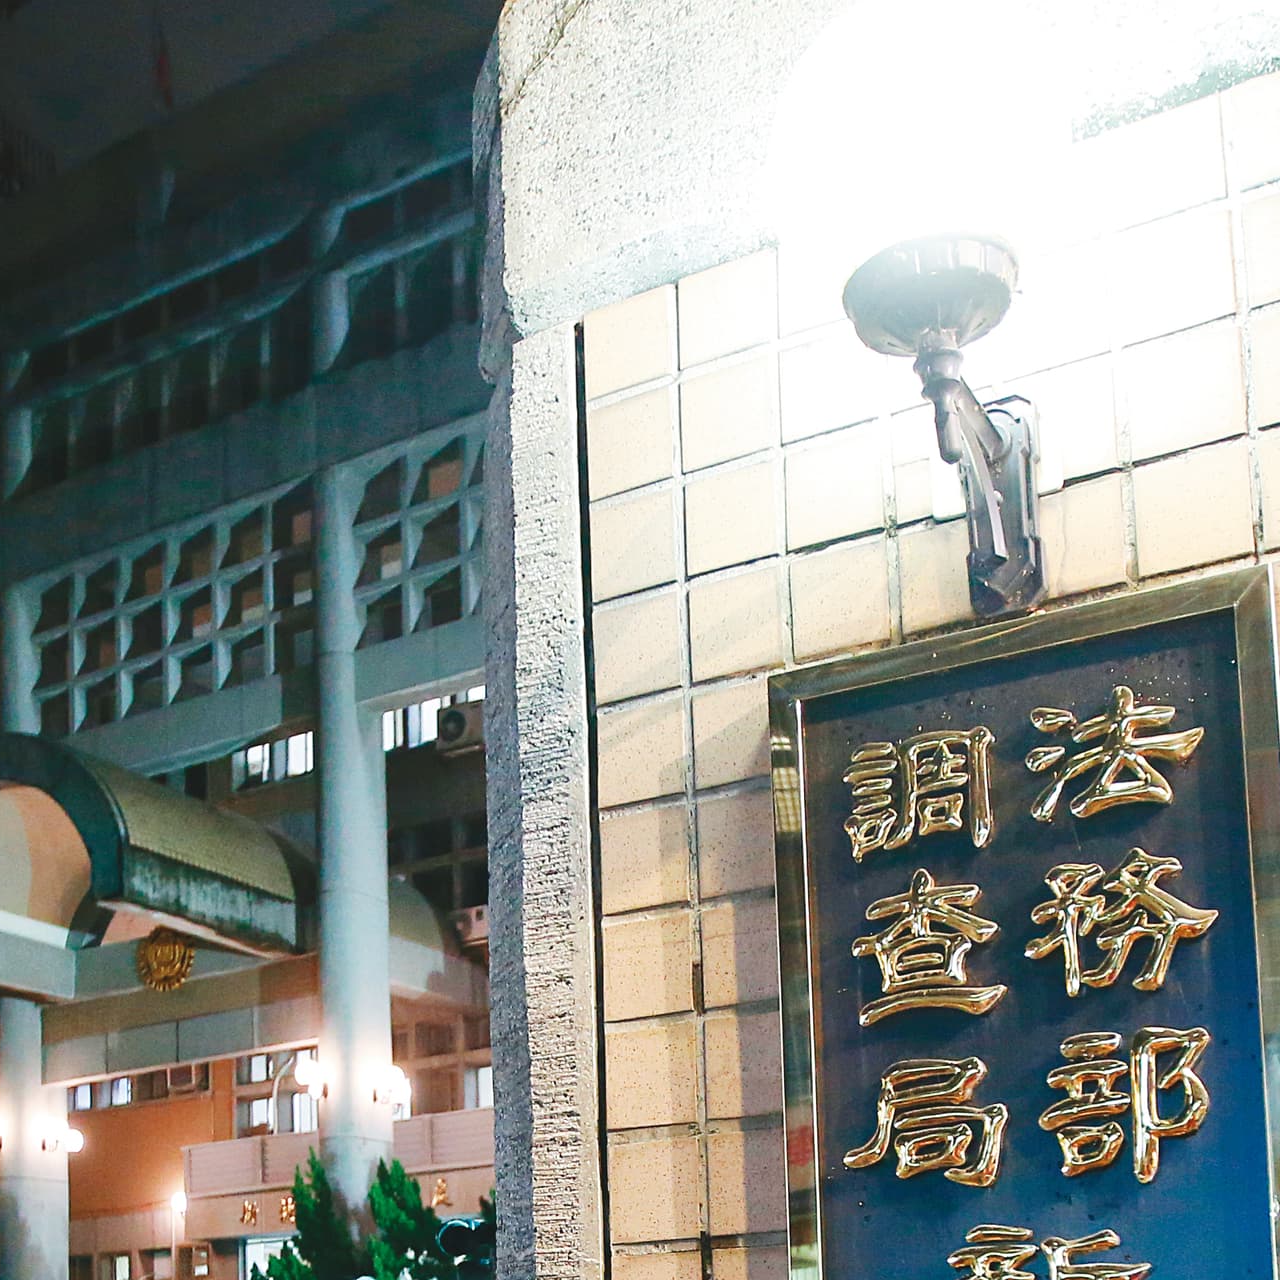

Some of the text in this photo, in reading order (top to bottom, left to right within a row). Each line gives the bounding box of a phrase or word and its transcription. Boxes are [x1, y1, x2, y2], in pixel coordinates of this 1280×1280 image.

[842, 725, 1009, 1188] 調查局
[1023, 685, 1220, 1184] 法務部
